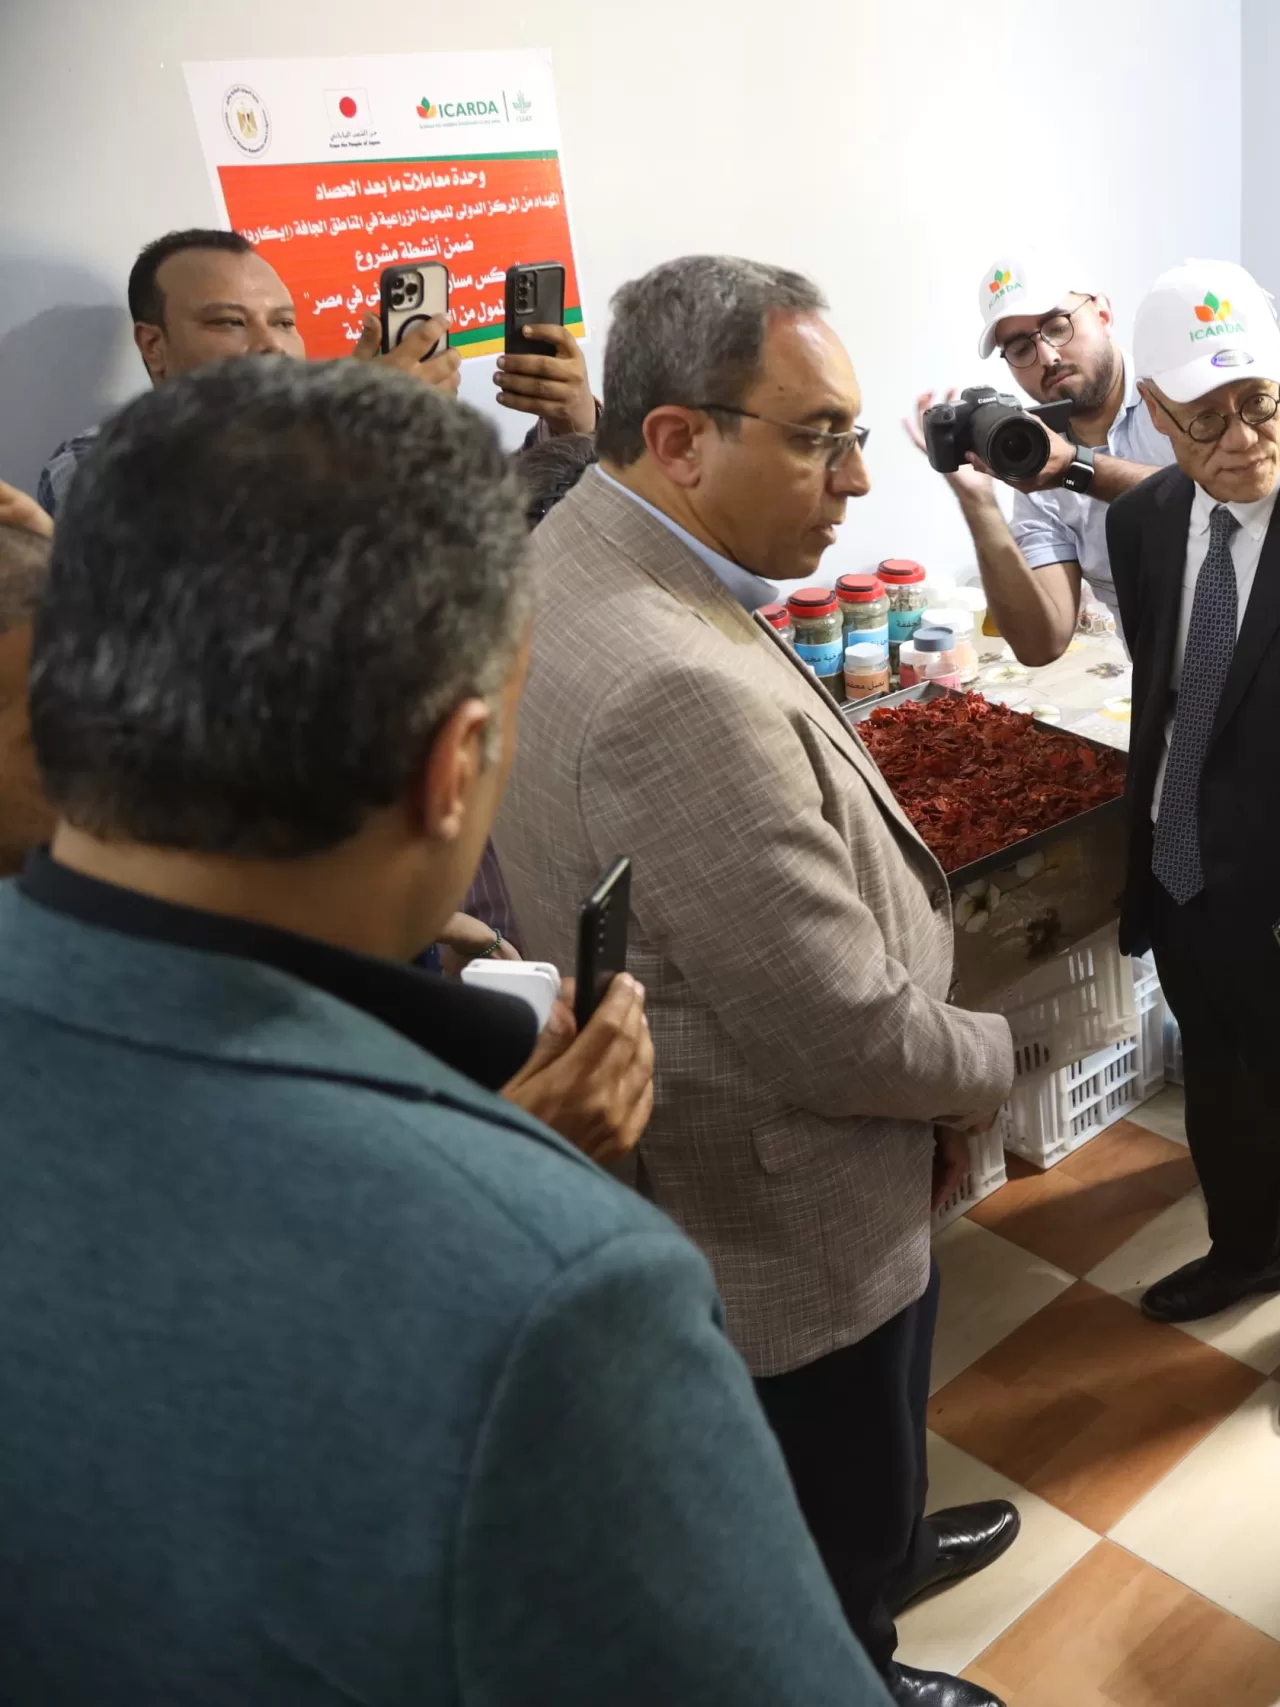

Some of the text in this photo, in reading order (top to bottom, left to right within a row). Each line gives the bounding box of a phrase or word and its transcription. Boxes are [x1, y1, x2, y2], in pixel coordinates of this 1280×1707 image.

[438, 101, 499, 118] ICARDA
[316, 167, 486, 200] وحدة معاملات ما بعد الحصاد
[421, 205, 453, 224] للبحوث
[487, 196, 520, 217] المركز
[521, 195, 534, 213] من
[293, 219, 327, 238] الجافة
[329, 214, 364, 237] المناطق
[378, 208, 419, 229] الزراعية
[355, 233, 474, 272] ضمن أنشطة مشروع
[346, 284, 363, 314] في
[459, 305, 476, 326] من
[1190, 323, 1245, 342] ICARDA
